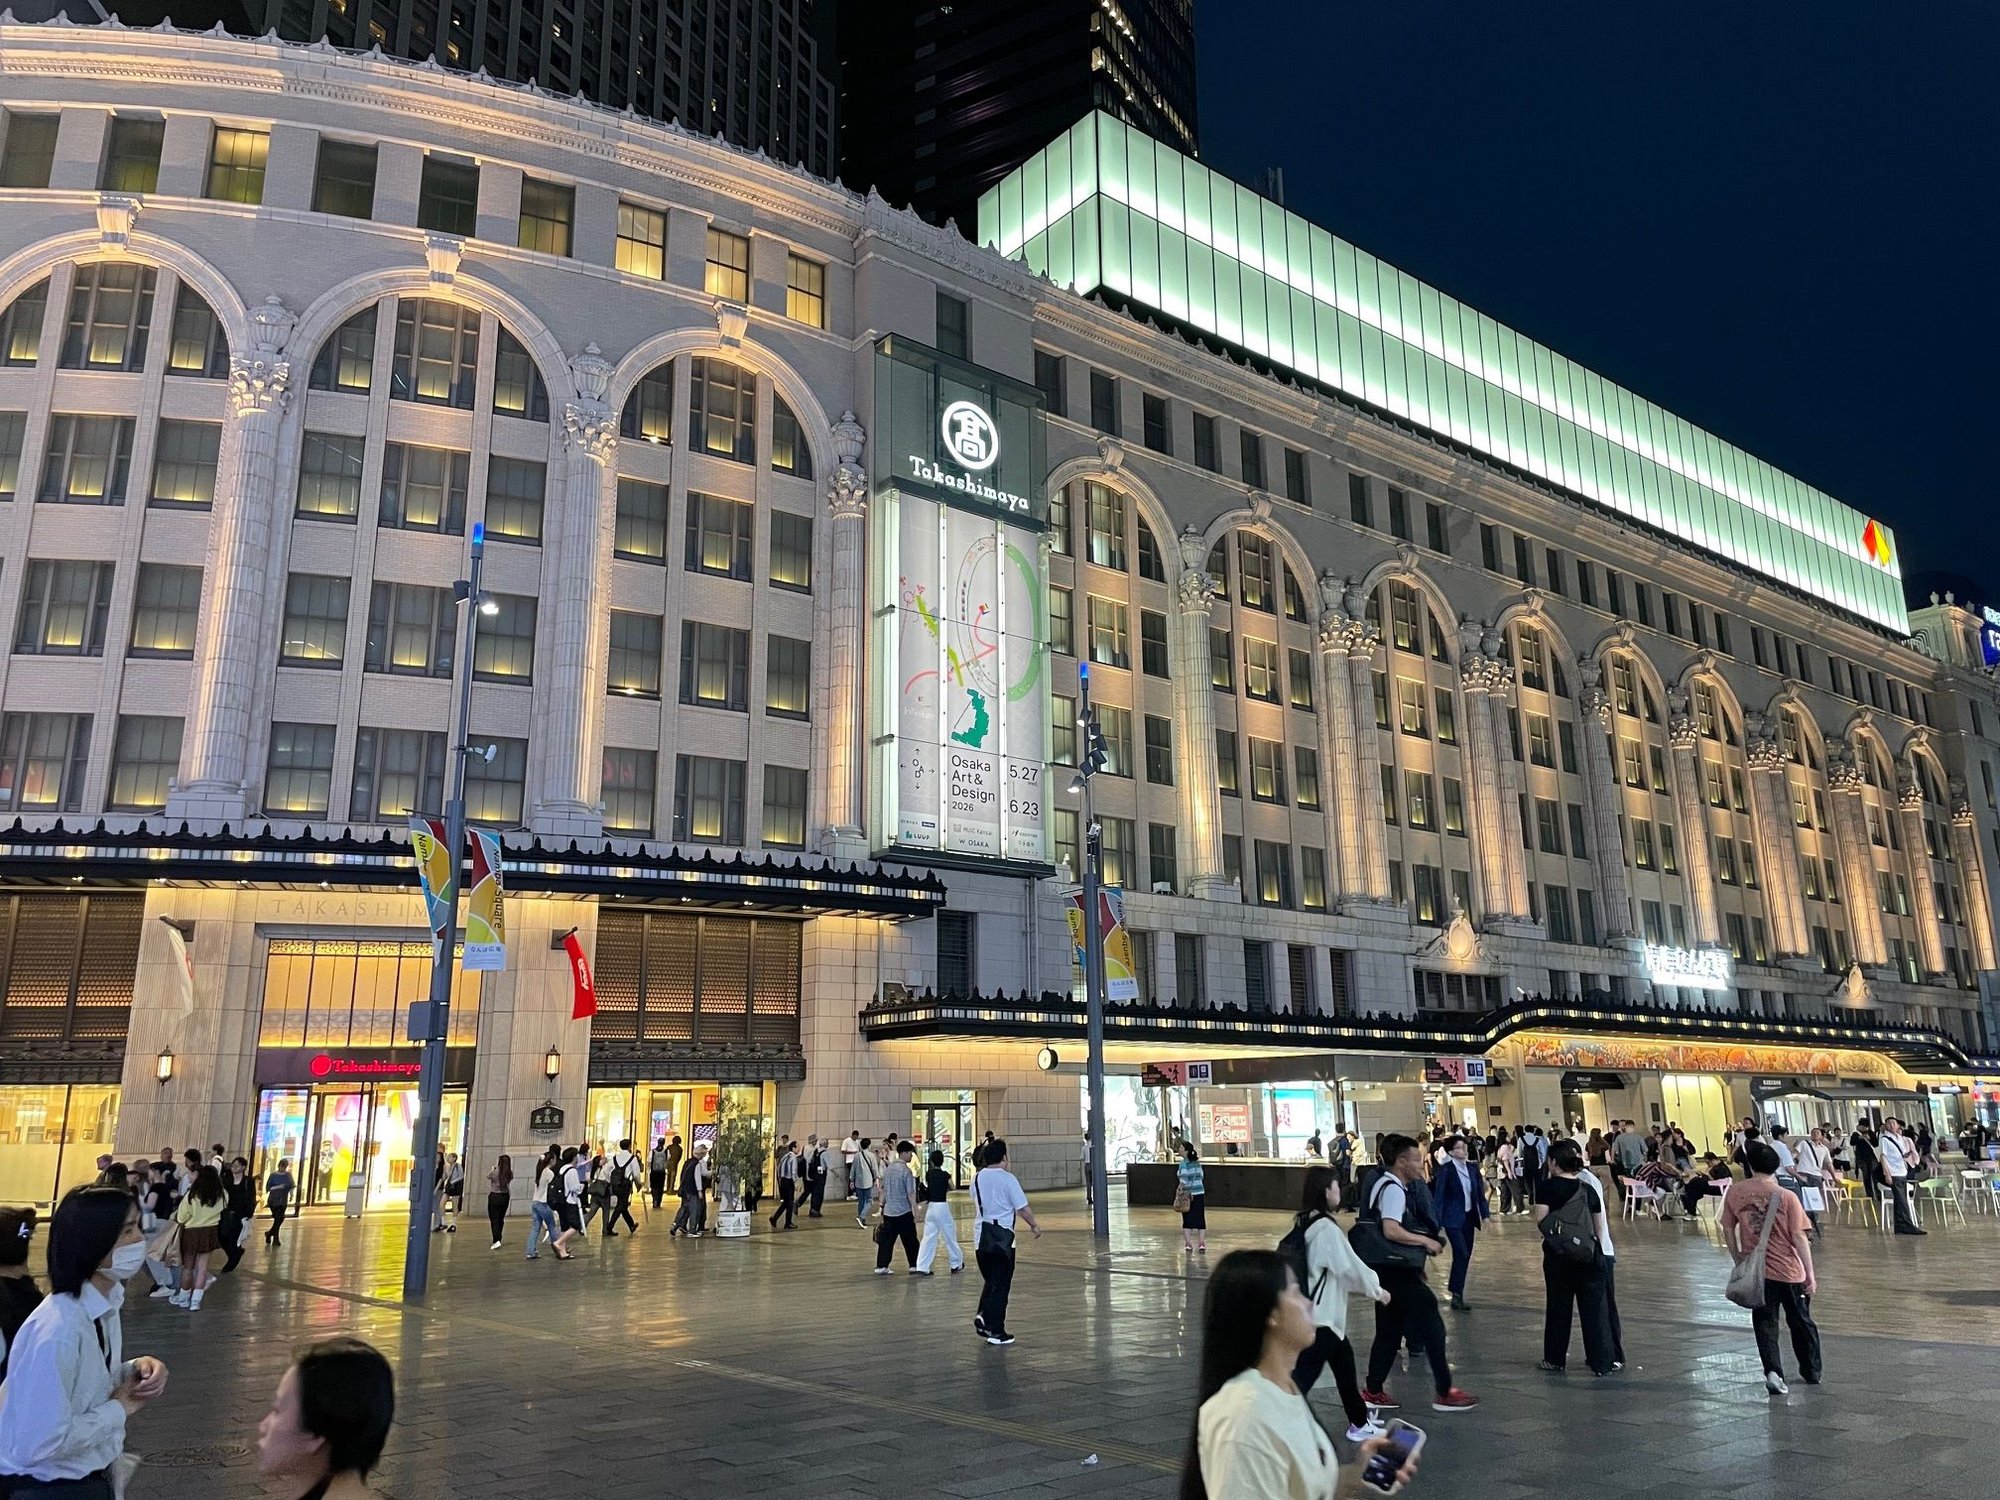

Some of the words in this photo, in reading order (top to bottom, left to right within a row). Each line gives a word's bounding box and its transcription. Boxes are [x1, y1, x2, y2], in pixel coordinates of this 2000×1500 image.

[909, 455, 1030, 512] Takashimaya
[951, 754, 991, 772] Osaka
[1009, 764, 1039, 782] 5.27
[951, 784, 996, 804] Design
[951, 800, 974, 813] 2026
[1009, 799, 1039, 817] 6.23
[968, 839, 990, 848] OSAKA
[493, 847, 504, 887] Namba
[272, 898, 468, 918] TAKASHIMY
[493, 888, 504, 930] Square
